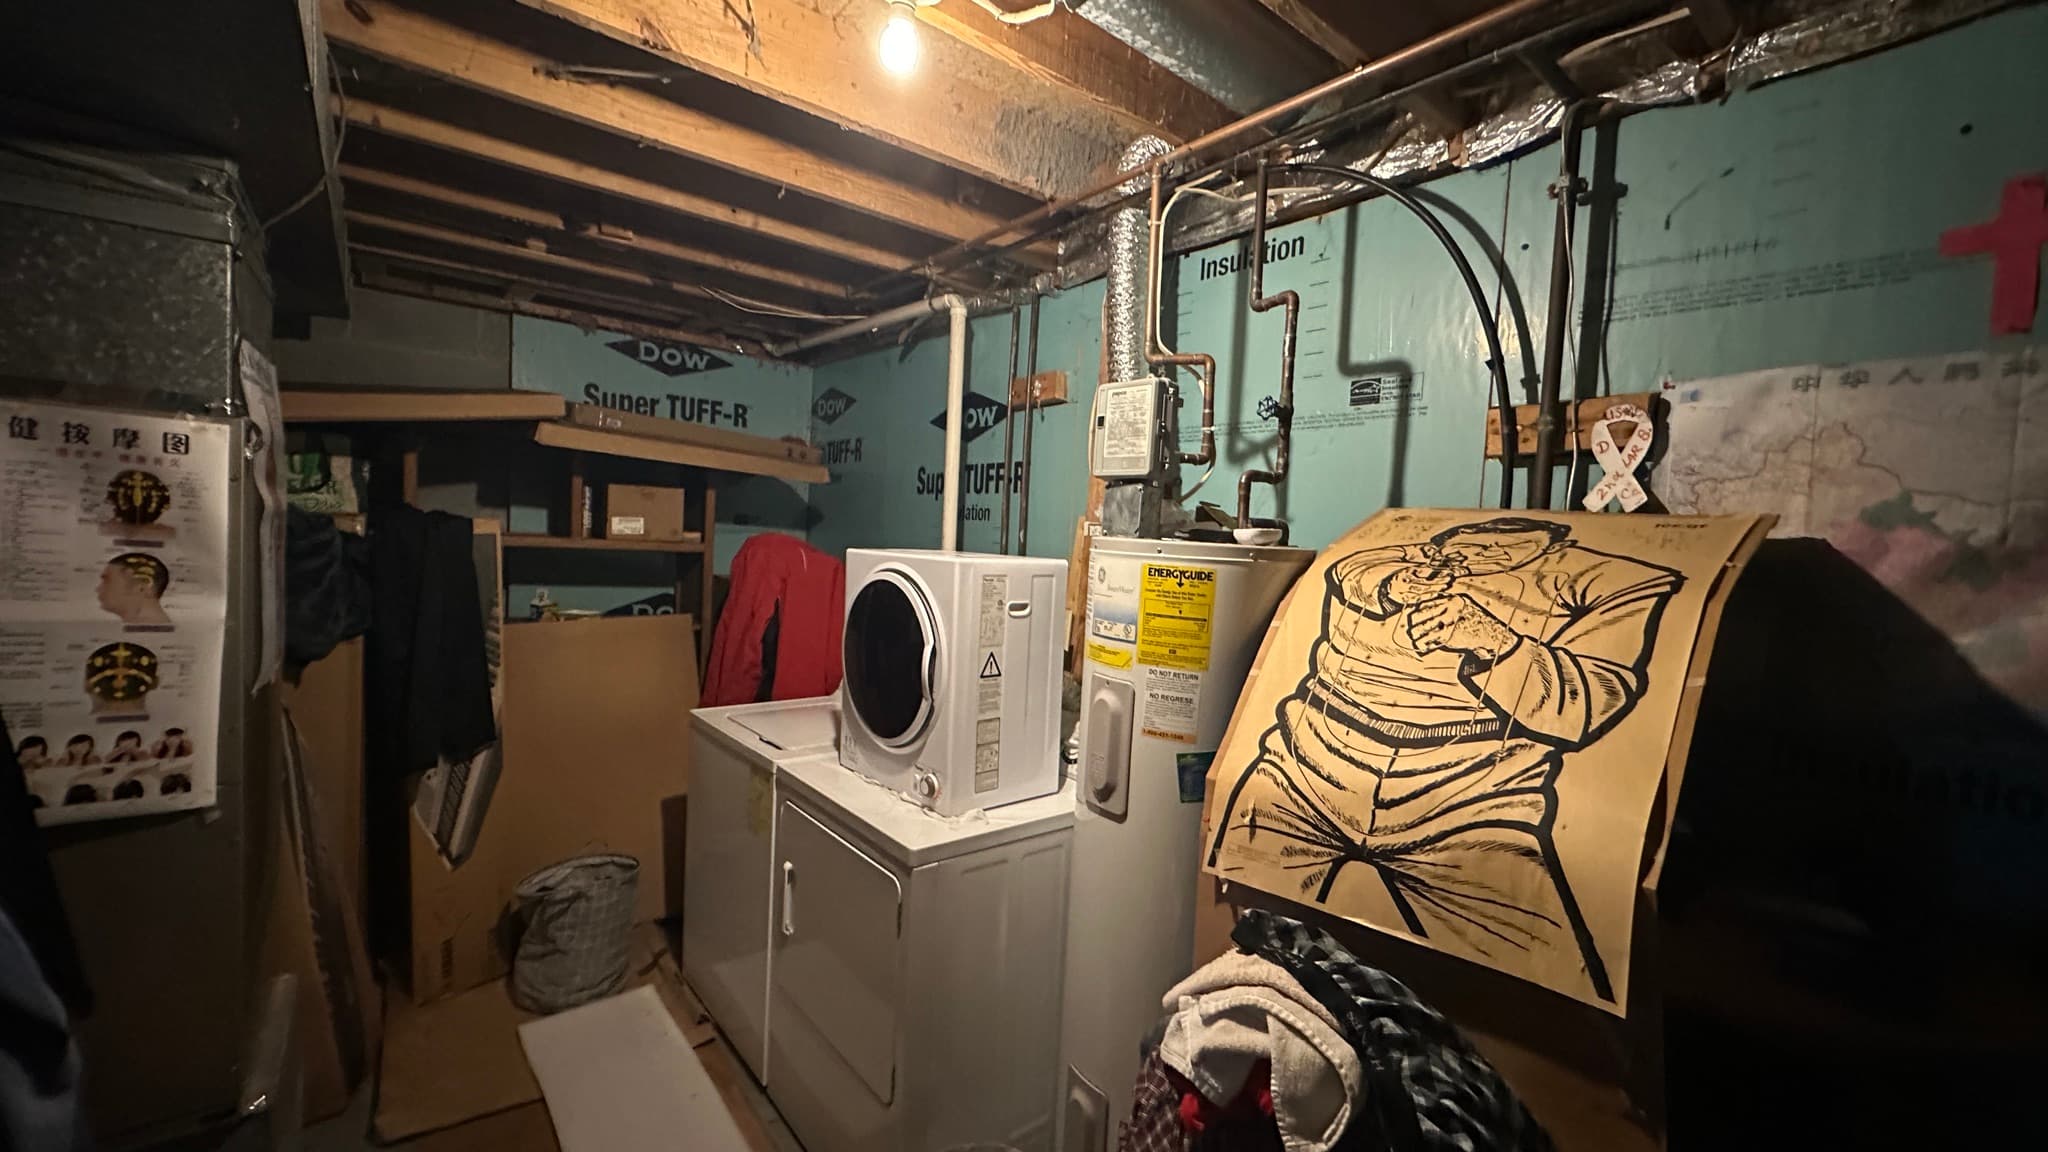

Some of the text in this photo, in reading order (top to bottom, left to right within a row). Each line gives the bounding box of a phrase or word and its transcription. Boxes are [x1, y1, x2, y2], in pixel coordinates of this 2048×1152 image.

[638, 340, 711, 370] DOW
[665, 394, 749, 429] TUFF-R
[817, 397, 848, 417] DOW
[964, 405, 999, 430] OW
[827, 438, 862, 466] TUFF-R
[916, 461, 1024, 501] Sup TUFF-R
[959, 504, 991, 522] lation
[632, 603, 675, 616] DO
[1148, 668, 1199, 681] DO NOT RETURN
